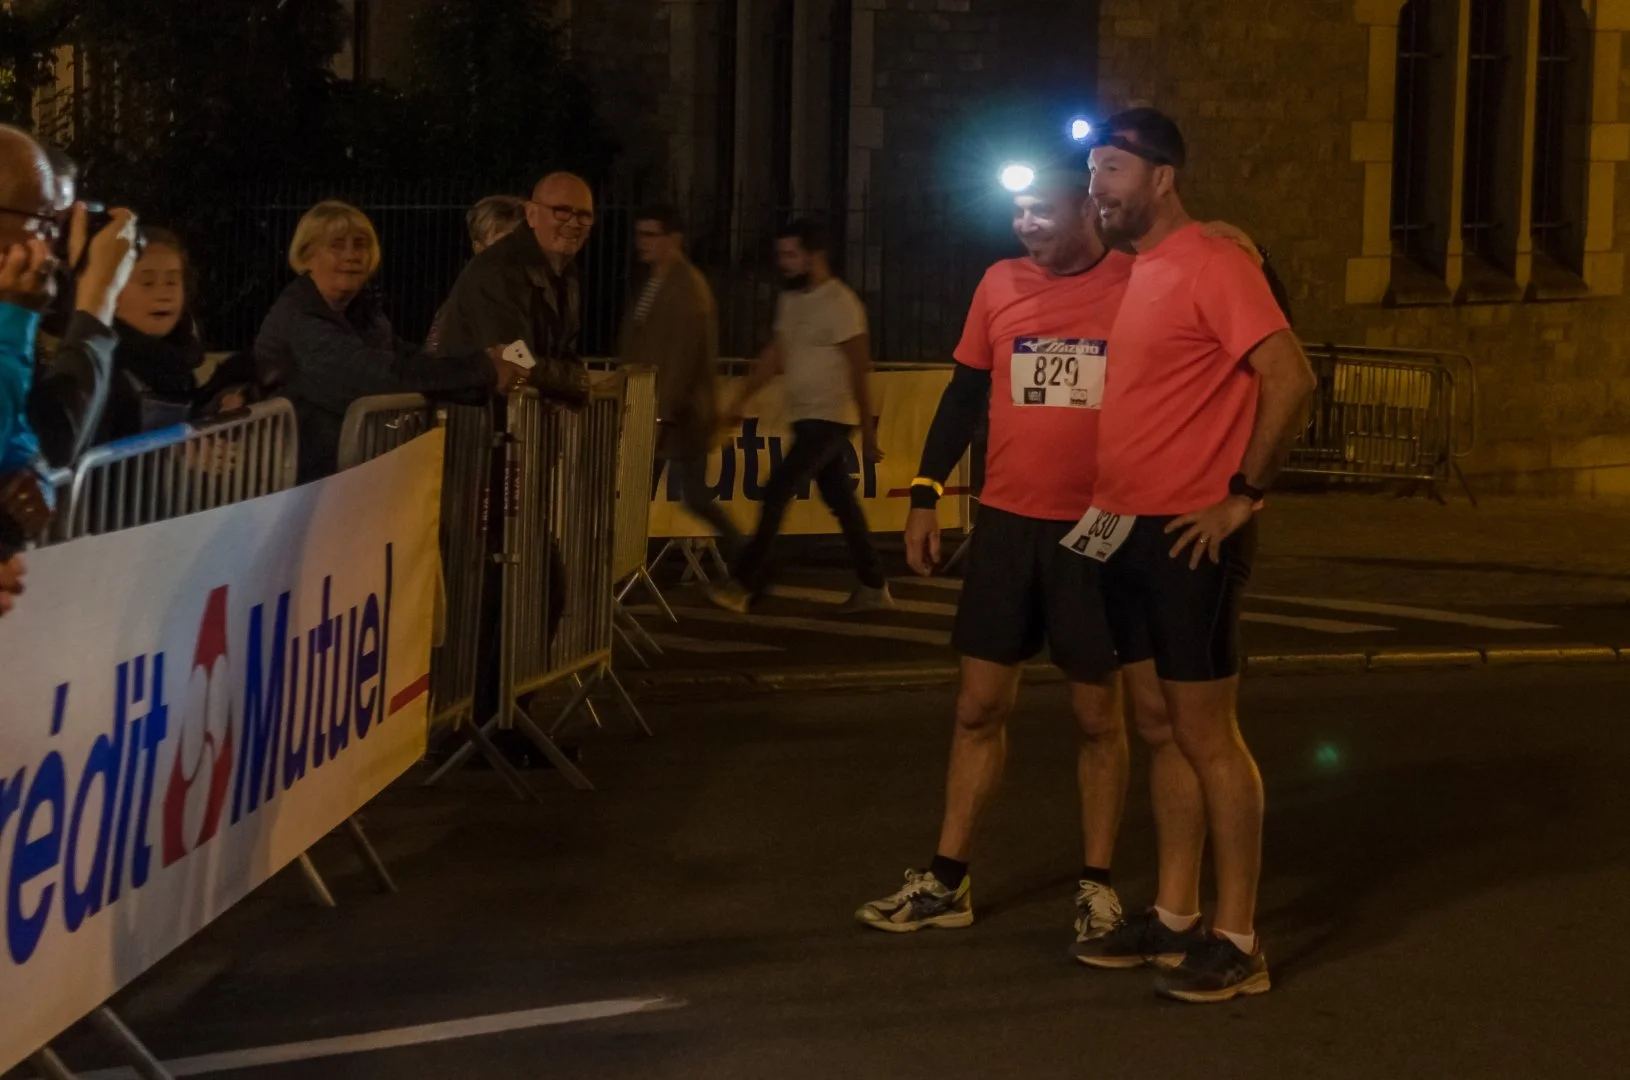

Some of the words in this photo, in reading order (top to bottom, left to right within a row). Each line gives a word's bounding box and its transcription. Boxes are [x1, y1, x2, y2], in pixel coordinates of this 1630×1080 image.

[1033, 356, 1079, 386] 829
[1087, 511, 1120, 539] 830
[230, 542, 393, 826] Mutuel
